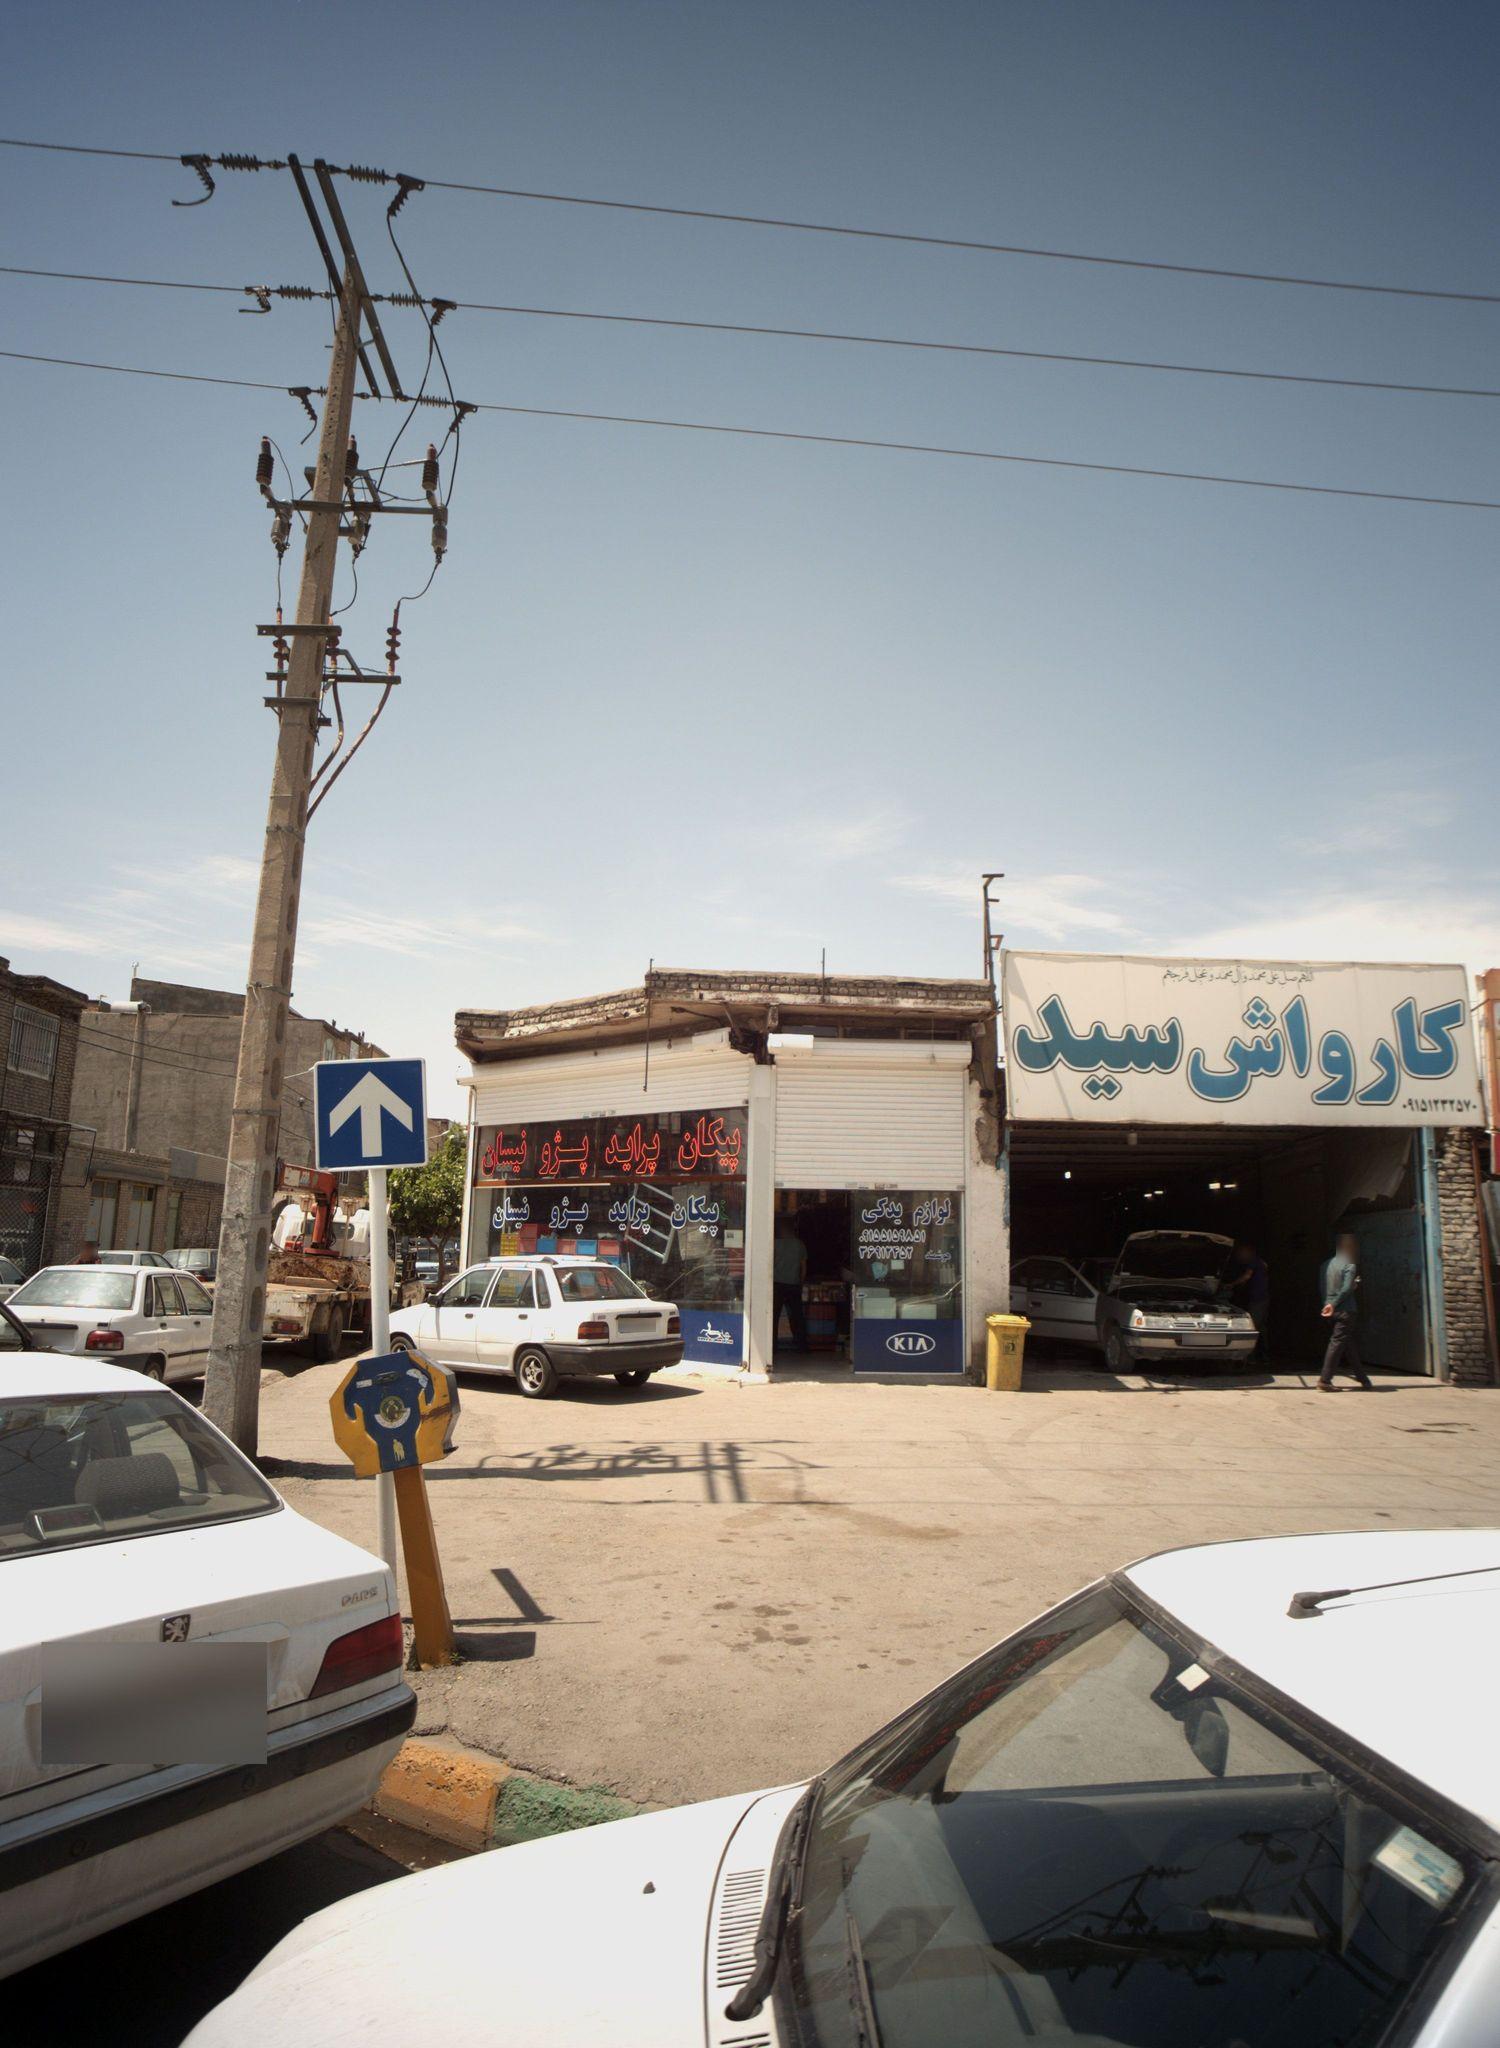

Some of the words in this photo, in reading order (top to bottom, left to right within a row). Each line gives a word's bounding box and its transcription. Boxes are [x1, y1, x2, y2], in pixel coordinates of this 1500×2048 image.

[1013, 993, 1183, 1100] سید
[1187, 994, 1466, 1105] کارواش
[482, 1128, 527, 1177] نیسان
[539, 1130, 589, 1175] پژو
[605, 1123, 661, 1175] پراید
[678, 1116, 742, 1173] پیکان
[492, 1196, 530, 1229] نیسان
[549, 1196, 589, 1234] پژو
[608, 1195, 651, 1236] پراید
[670, 1195, 720, 1237] پیکان
[862, 1197, 903, 1225] یدکی
[913, 1197, 951, 1227] لوازم
[894, 1337, 928, 1351] KIA
[341, 1586, 378, 1607] PARS
